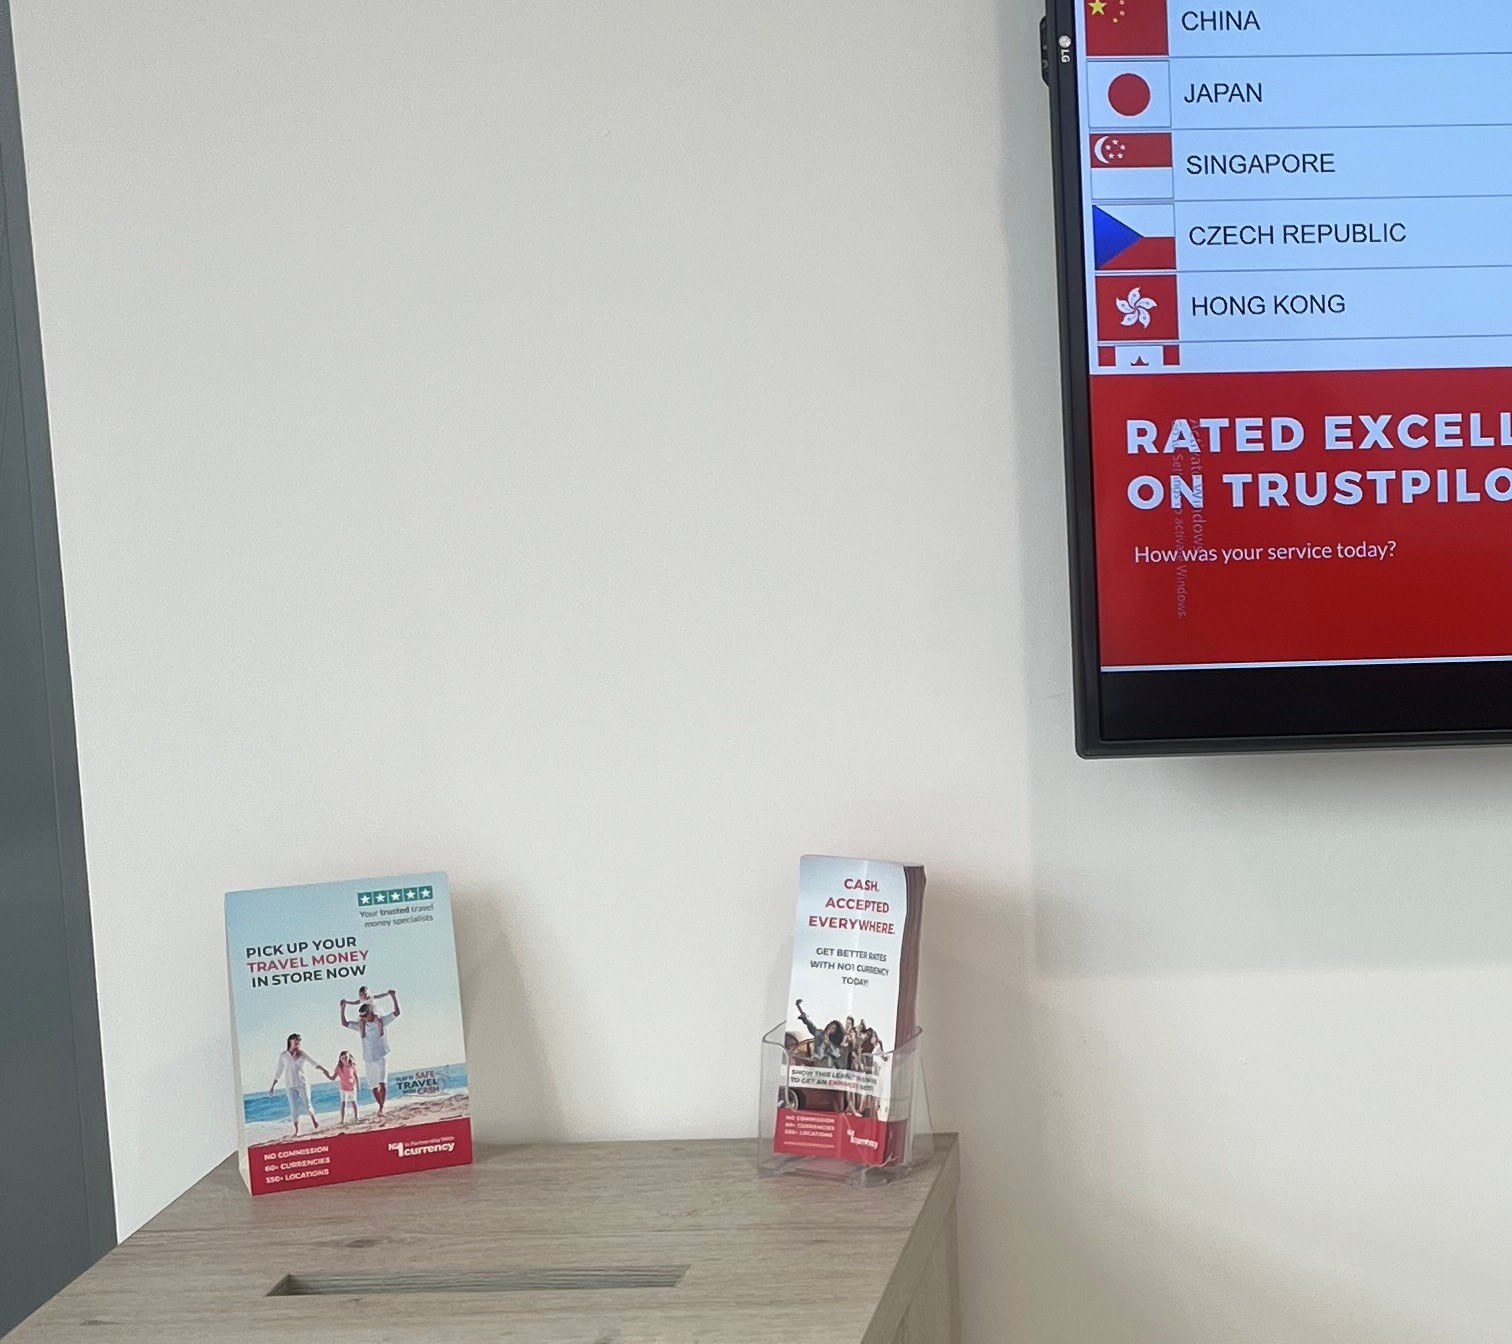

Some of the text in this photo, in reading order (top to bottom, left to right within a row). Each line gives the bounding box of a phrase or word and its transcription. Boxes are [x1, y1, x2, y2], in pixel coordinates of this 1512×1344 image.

[1182, 10, 1260, 31] CHINA
[1060, 49, 1071, 62] LG
[1184, 83, 1262, 103] JAPAN
[1187, 153, 1335, 174] SINGAPORE
[1189, 223, 1406, 245] CZECH REPUBLIC
[1192, 295, 1345, 316] HONG KONG
[1127, 417, 1304, 453] RATED
[1128, 475, 1203, 509] ON
[1134, 540, 1396, 564] How was your service today?
[380, 906, 410, 916] trusted
[825, 897, 890, 914] ACCEPTED
[246, 936, 356, 958] PICK UP YOUR
[816, 948, 834, 956] GET
[837, 949, 868, 958] BETTER
[247, 950, 369, 973] TRAVEL MONEY
[810, 960, 834, 970] WITH
[252, 964, 366, 988] IN STORE NOW
[397, 1078, 438, 1090] TRAVEL
[404, 1142, 455, 1156] currency
[284, 1168, 330, 1180] LOCATIONS
